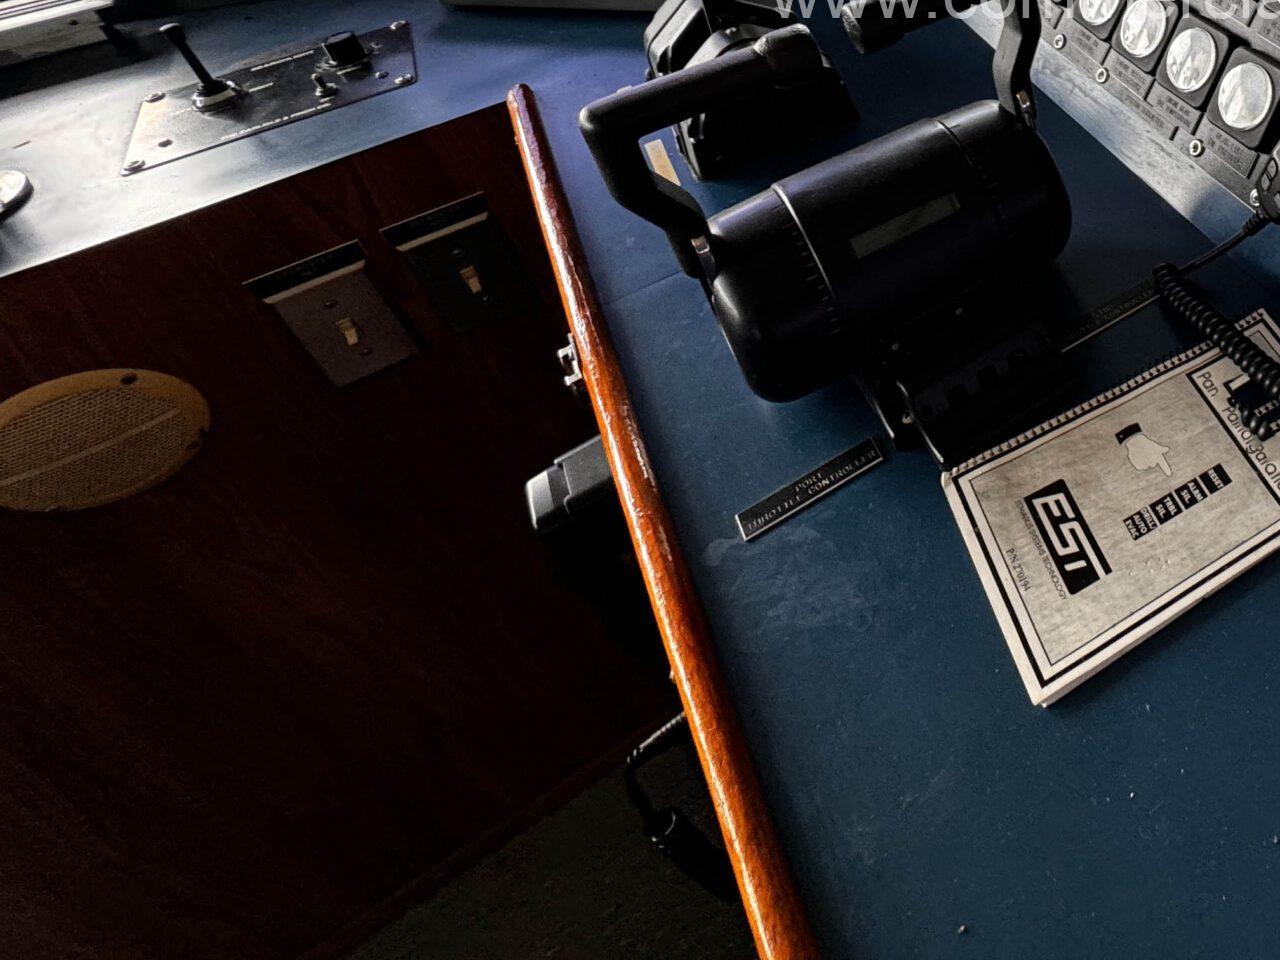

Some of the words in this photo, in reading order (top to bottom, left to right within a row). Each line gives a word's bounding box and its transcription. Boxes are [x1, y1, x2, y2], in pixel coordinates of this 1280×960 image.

[807, 450, 876, 495] CONTROLLER
[1207, 469, 1223, 489] RESET
[795, 473, 823, 492] PORT
[1188, 481, 1202, 500] ALRM
[1163, 497, 1176, 515] TRBL
[1125, 519, 1138, 537] EVAC
[1133, 513, 1147, 533] AUTO
[1006, 548, 1017, 563] P/N
[1042, 556, 1066, 601] TECHNOLOGY
